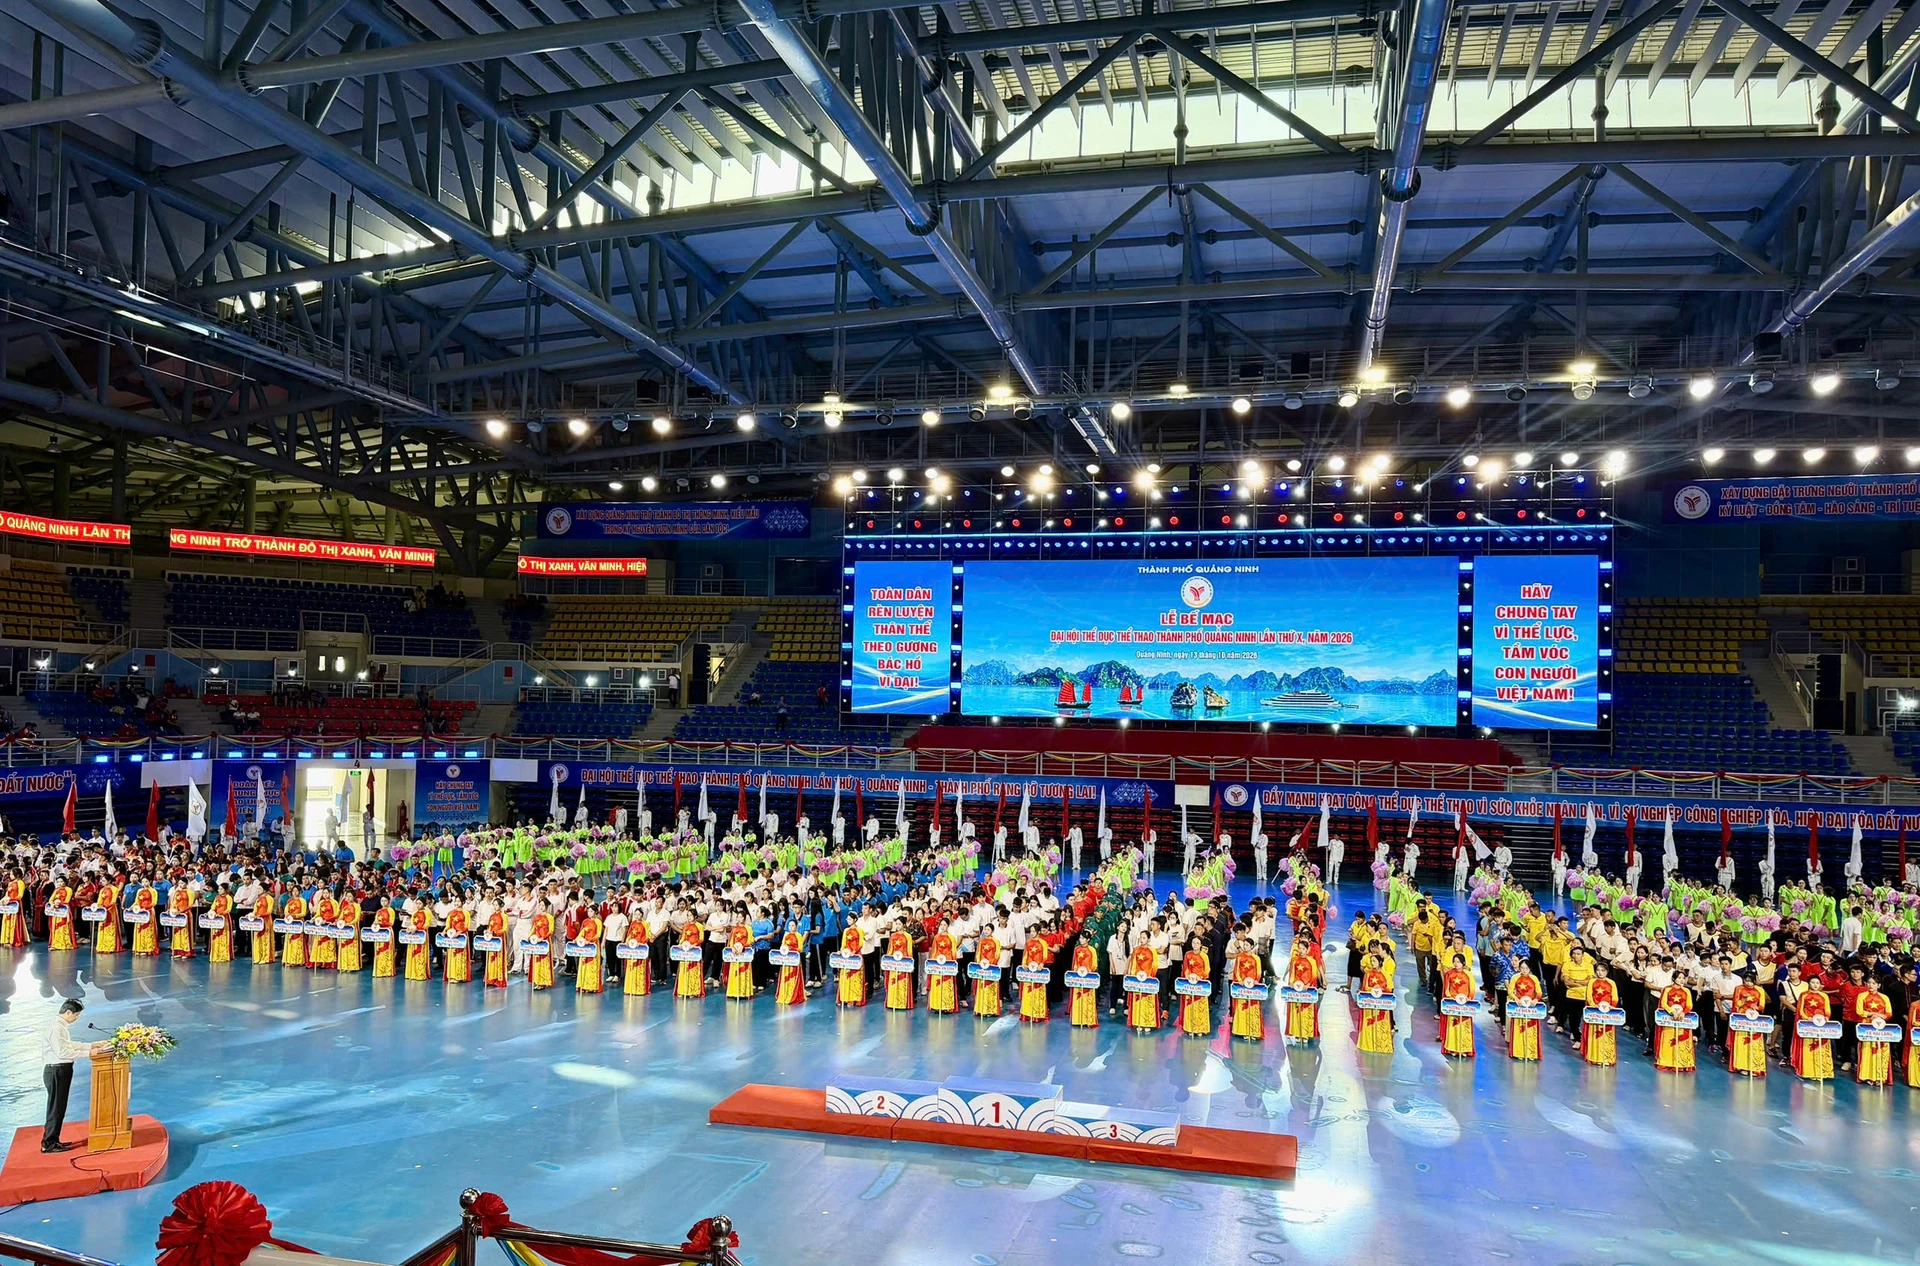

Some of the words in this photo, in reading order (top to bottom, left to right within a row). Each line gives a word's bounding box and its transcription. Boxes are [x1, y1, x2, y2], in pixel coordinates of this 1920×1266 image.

[1721, 485, 1741, 500] XÂY
[1742, 486, 1769, 501] DỰNG
[1771, 484, 1791, 500] ĐẶC
[1792, 485, 1825, 498] TRƯNG
[1827, 482, 1859, 497] NGƯỜI
[1860, 480, 1894, 496] THÀNH
[1895, 479, 1917, 495] PHỐ
[1734, 503, 1758, 518] LUẬT
[1794, 501, 1816, 515] TÂM
[1884, 499, 1900, 513] TRÍ
[7, 516, 46, 532] QUẢNG
[49, 523, 79, 536] NINH
[190, 535, 220, 547] NINH
[224, 536, 253, 549] TRỞ
[254, 538, 296, 552] THÀNH
[298, 541, 316, 553] ĐÔ
[319, 544, 338, 557] THỊ
[341, 546, 376, 559] XANH,
[378, 547, 402, 560] VĂN
[530, 561, 546, 572] THỊ
[548, 562, 576, 572] XANH,
[578, 560, 597, 570] VĂN
[599, 562, 624, 572] MINH,
[1137, 565, 1169, 574] THÀNH
[1172, 564, 1193, 573] PHỐ
[1195, 564, 1232, 573] QUẢNG
[1234, 565, 1259, 573] NINH
[871, 586, 903, 600] TOÀN
[906, 586, 932, 600] DÂN
[1521, 583, 1552, 599] HÃY
[868, 604, 892, 618] RÈN
[895, 604, 934, 620] LUYỆN
[1161, 608, 1177, 626] LỄ
[1180, 609, 1199, 626] BẾ
[1201, 612, 1234, 629] MẠC
[1496, 605, 1548, 619] CHUNG
[1551, 605, 1578, 619] TAY
[873, 621, 905, 635] THÂN
[908, 620, 932, 635] THỂ
[1050, 629, 1064, 645] ĐẠI
[1066, 628, 1080, 645] HỘI
[1081, 626, 1097, 643] THỂ
[1098, 630, 1114, 645] DỤC
[1116, 626, 1133, 643] THỂ
[1133, 631, 1154, 643] THAO
[1155, 629, 1183, 643] THÀNH
[1185, 627, 1203, 643] PHỐ
[1204, 628, 1233, 645] QUẢNG
[1235, 631, 1256, 644] NINH
[1277, 629, 1296, 643] THỨ
[1296, 631, 1305, 645] X,
[1307, 629, 1328, 644] NĂM
[1330, 632, 1353, 644] 2026
[1494, 623, 1510, 640] VÌ
[1513, 621, 1542, 639] THỂ
[1544, 625, 1579, 642] LỰC,
[863, 641, 893, 652] THEO
[896, 641, 938, 653] GƯƠNG
[1136, 650, 1155, 660] Quảng
[1156, 651, 1172, 660] Ninh,
[1173, 651, 1188, 660] ngày
[1189, 651, 1198, 659] 13
[1199, 651, 1216, 660] tháng
[1217, 651, 1226, 659] 10
[1226, 651, 1241, 660] năm
[1241, 652, 1258, 660] 2026
[1502, 642, 1536, 660] TẦM
[1539, 644, 1570, 660] VÓC
[877, 656, 902, 670] BÁC
[905, 656, 922, 670] HỒ
[1494, 666, 1526, 680] CON
[1530, 665, 1578, 680] NGƯỜI
[879, 674, 891, 687] VĨ
[893, 676, 919, 690] ĐẠI!
[1496, 684, 1529, 702] VIỆT
[1532, 687, 1575, 701] NAM!
[354, 760, 360, 768] 4
[581, 769, 596, 784] ĐẠI
[598, 767, 615, 785] HỘI
[616, 766, 635, 783] THỂ
[656, 766, 674, 784] THỂ
[732, 769, 752, 787] PỐ
[787, 774, 810, 789] NIH
[867, 774, 899, 792] QUẢNG
[936, 778, 968, 795] HÀH
[970, 778, 991, 796] PHỐ
[993, 782, 1021, 797] RNG
[1076, 785, 1096, 799] LAI!
[1263, 785, 1283, 805] ĐẨY
[1285, 791, 1316, 809] MẠNH
[1378, 790, 1399, 810] THỂ
[1424, 792, 1445, 812] THỂ
[1446, 798, 1474, 814] THO
[1476, 797, 1487, 814] VÌ
[1490, 797, 1511, 815] SỨC
[1514, 797, 1543, 817] KHỎE
[1545, 800, 1577, 818] NÂN
[1579, 801, 1606, 820] DN,
[1609, 802, 1620, 820] VÌ
[1685, 804, 1717, 823] CÔNG
[1826, 811, 1847, 831] ĐẠI
[1876, 810, 1900, 831] ĐẤT
[876, 1095, 885, 1110] 2
[991, 1101, 1001, 1124] 1
[1109, 1124, 1118, 1138] 3
